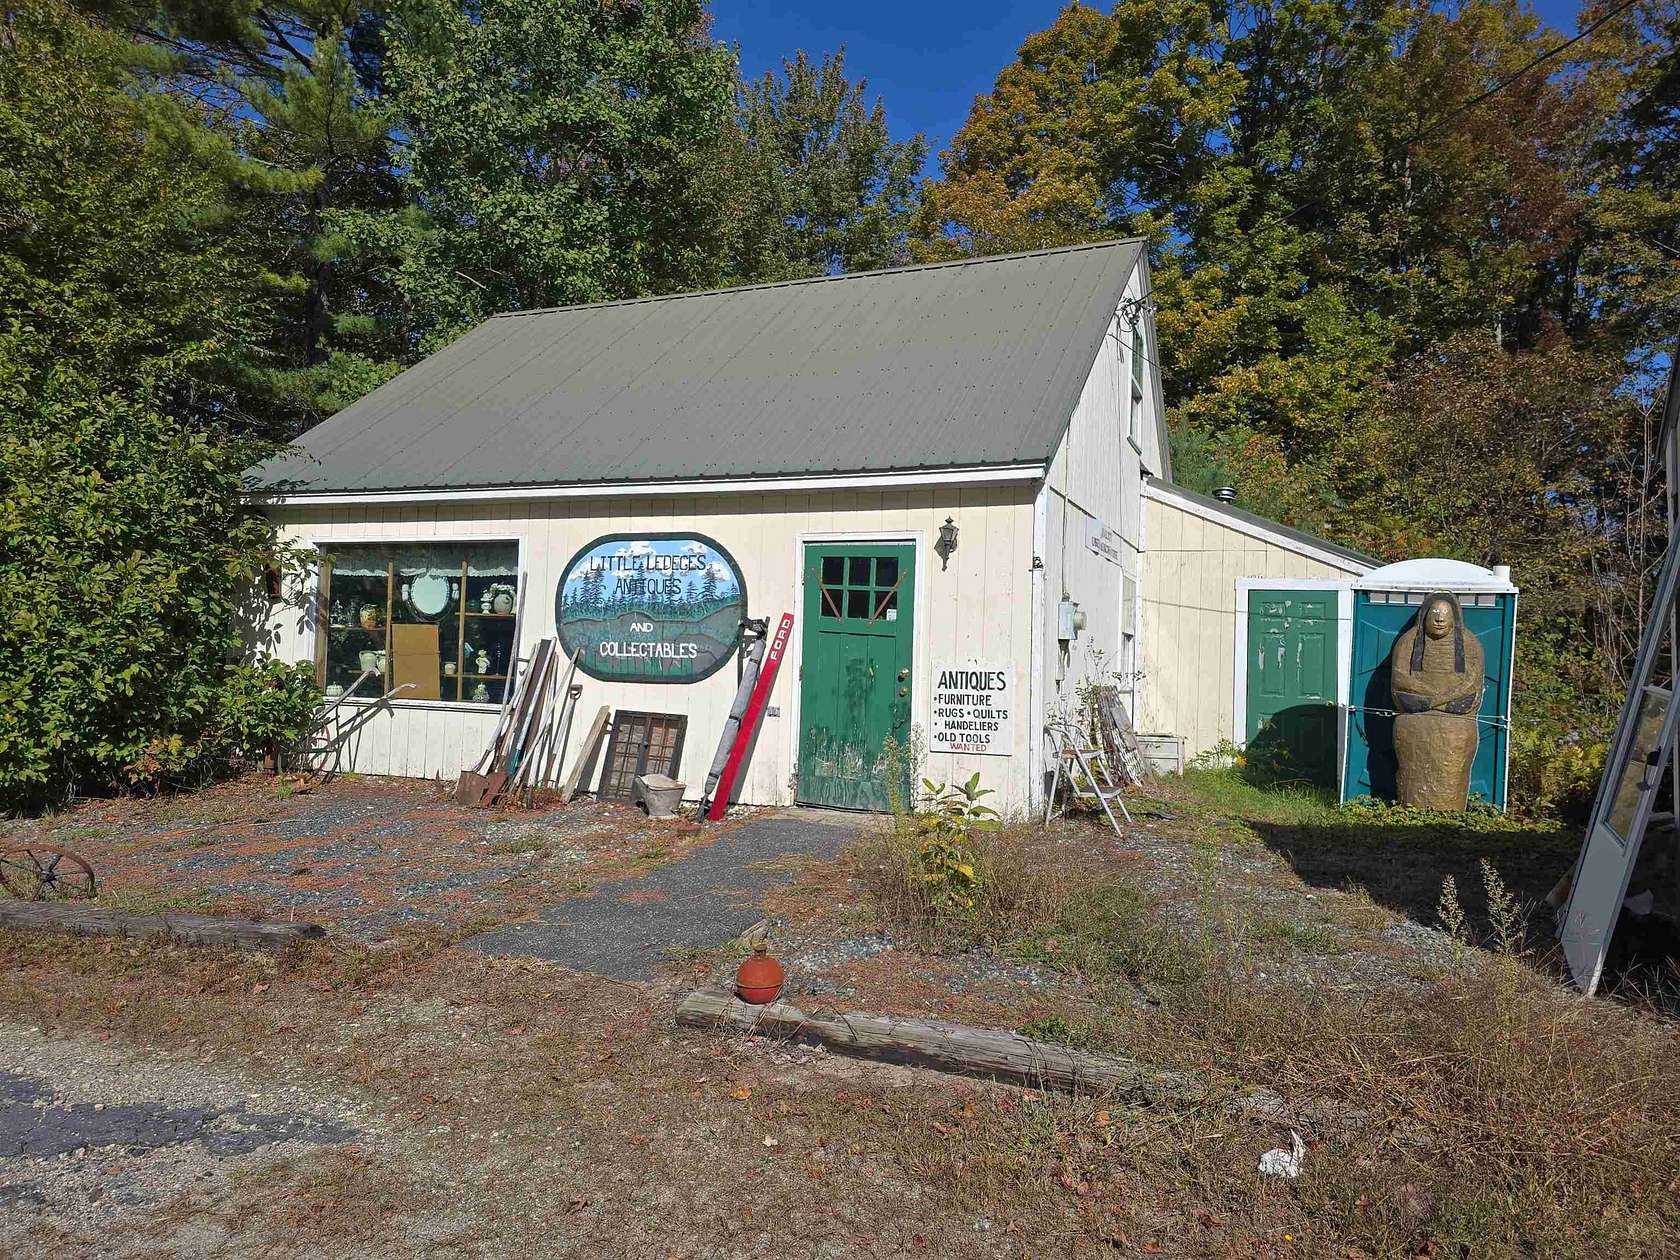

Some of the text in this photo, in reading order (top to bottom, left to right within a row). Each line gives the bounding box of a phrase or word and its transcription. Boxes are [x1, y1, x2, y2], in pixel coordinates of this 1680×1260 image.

[590, 556, 640, 571] LITTLE
[613, 578, 682, 595] ANTIQUES
[630, 622, 654, 632] AND
[770, 619, 790, 660] FORD
[600, 642, 697, 658] COLLECTABLES
[937, 671, 1006, 691] ANTIQUES
[938, 693, 992, 706] FURNITURE
[938, 708, 1008, 720] RUGS QUILTS
[939, 720, 999, 731] HANDELIERS
[937, 732, 991, 744] OLD TOOLS
[949, 743, 987, 752] WANTED
